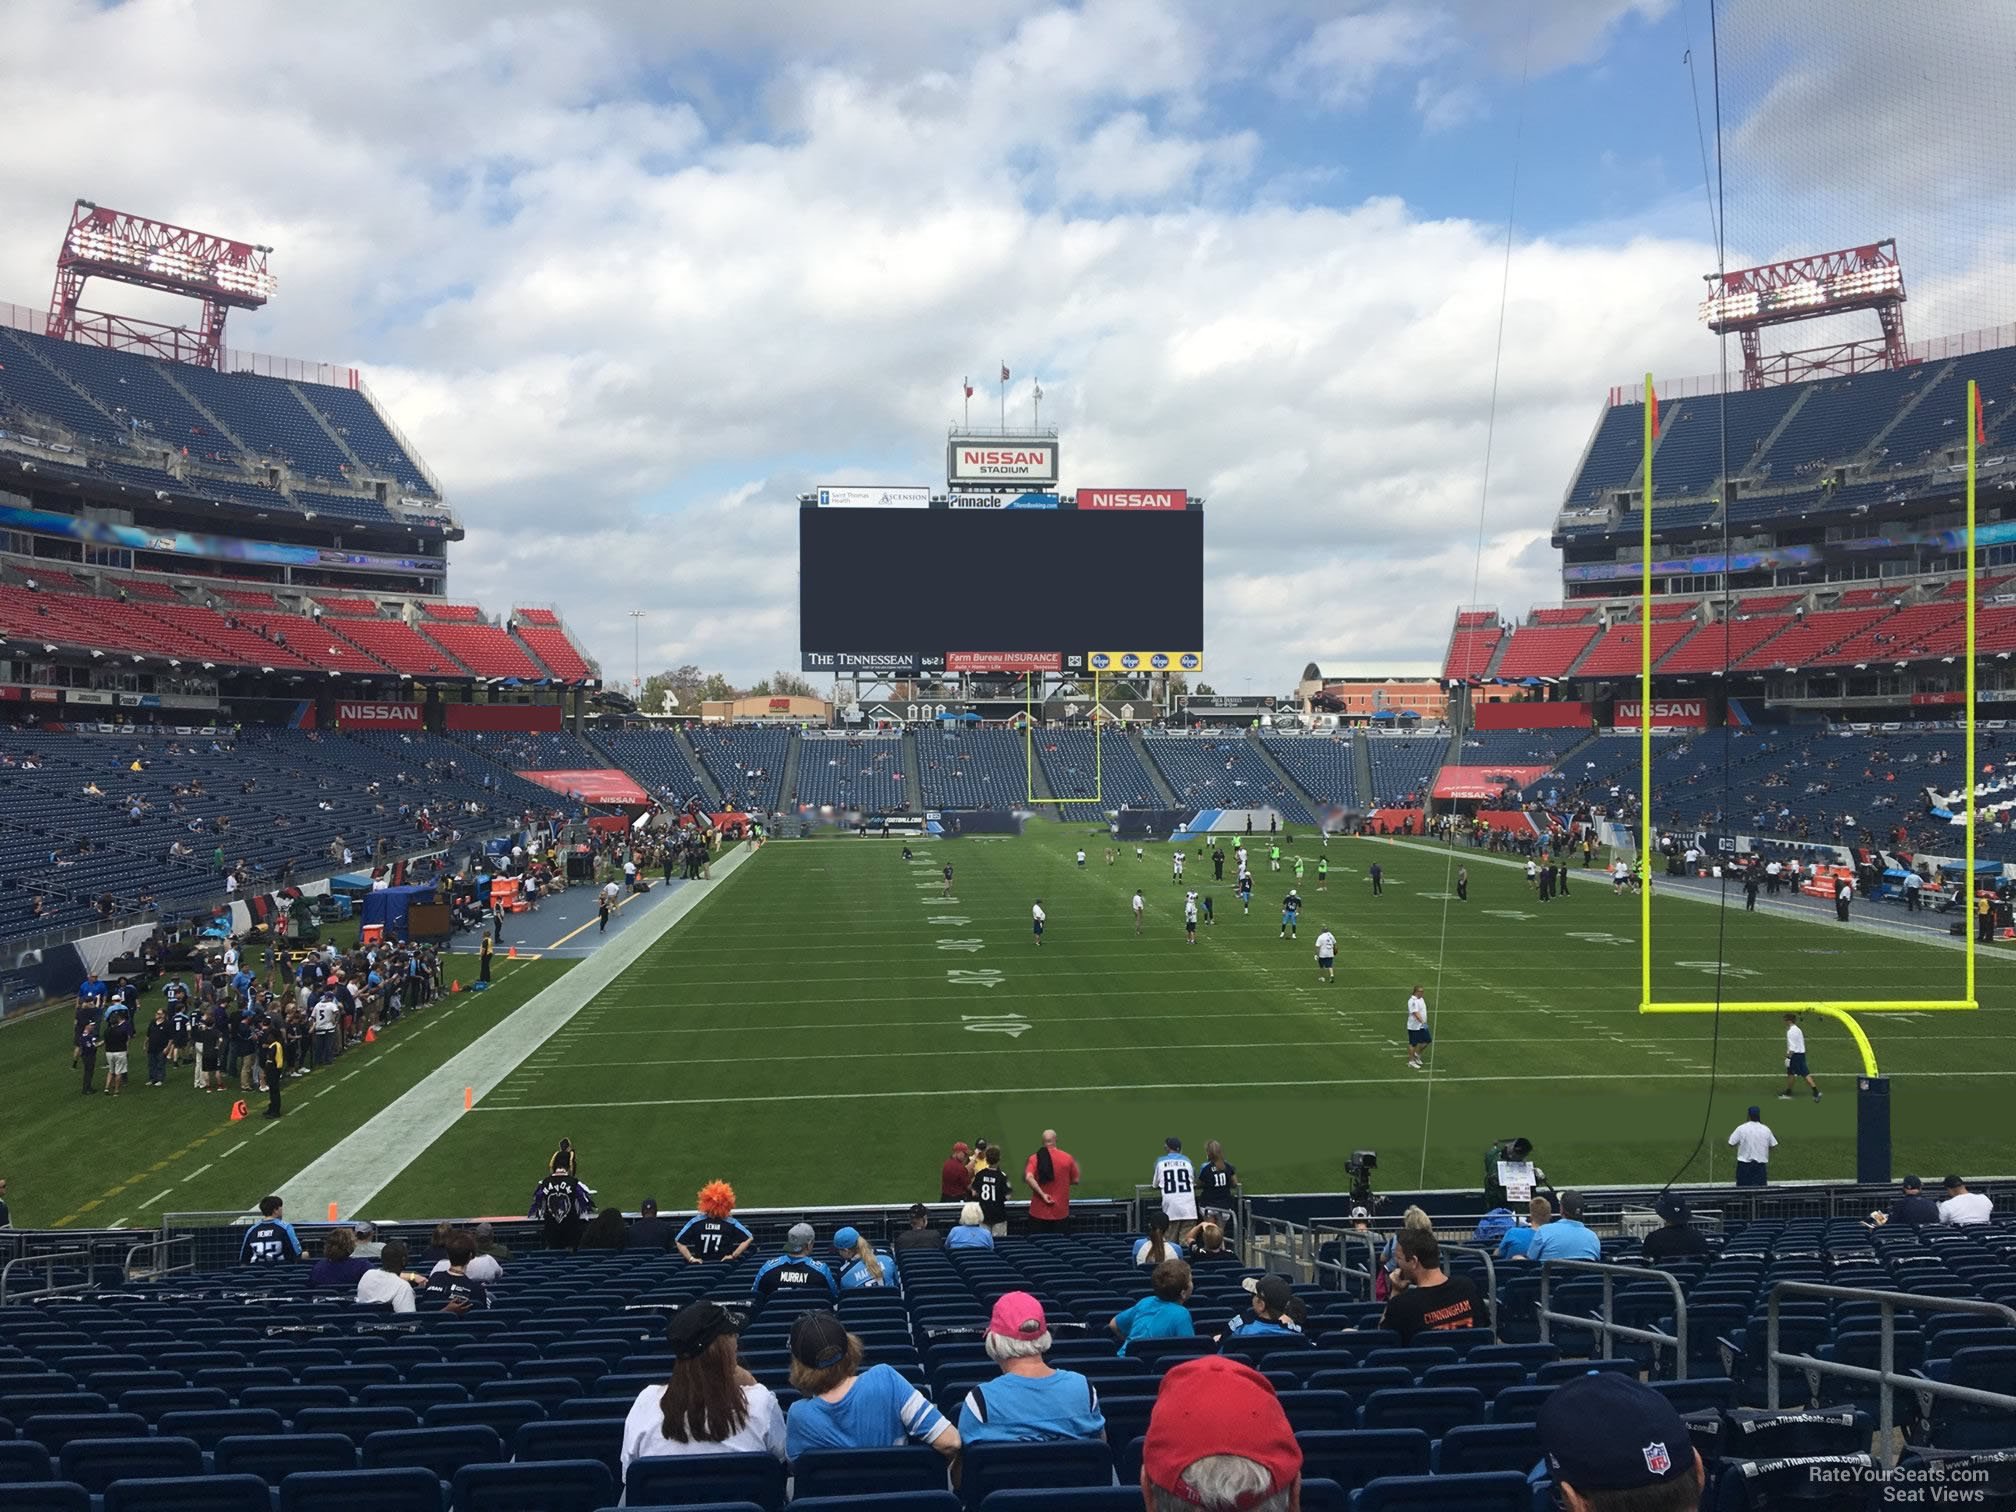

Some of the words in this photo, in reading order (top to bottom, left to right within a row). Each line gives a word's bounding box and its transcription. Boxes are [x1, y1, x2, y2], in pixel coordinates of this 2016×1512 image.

[965, 452, 1044, 464] NISSAN
[980, 466, 1029, 474] STADIUM
[950, 495, 1001, 507] Pinnacle
[1093, 494, 1171, 507] NISSAN
[809, 653, 834, 665] THE
[837, 653, 913, 665] TENNESSEAN
[1004, 654, 1058, 662] INSURANCE
[341, 705, 418, 719] NISSAN
[320, 1010, 325, 1020] 5
[238, 1101, 247, 1116] G
[1164, 1169, 1191, 1194] 89
[1214, 1173, 1226, 1187] 10
[542, 1181, 572, 1195] HAVOK
[981, 1184, 996, 1201] 81
[700, 1234, 722, 1253] 77
[250, 1241, 284, 1263] 22
[780, 1271, 809, 1283] MURRAY
[1424, 1300, 1471, 1325] CUNNINGHAM
[1756, 1413, 1843, 1431] www.TitansSeats.com
[1650, 1456, 1669, 1470] NFL
